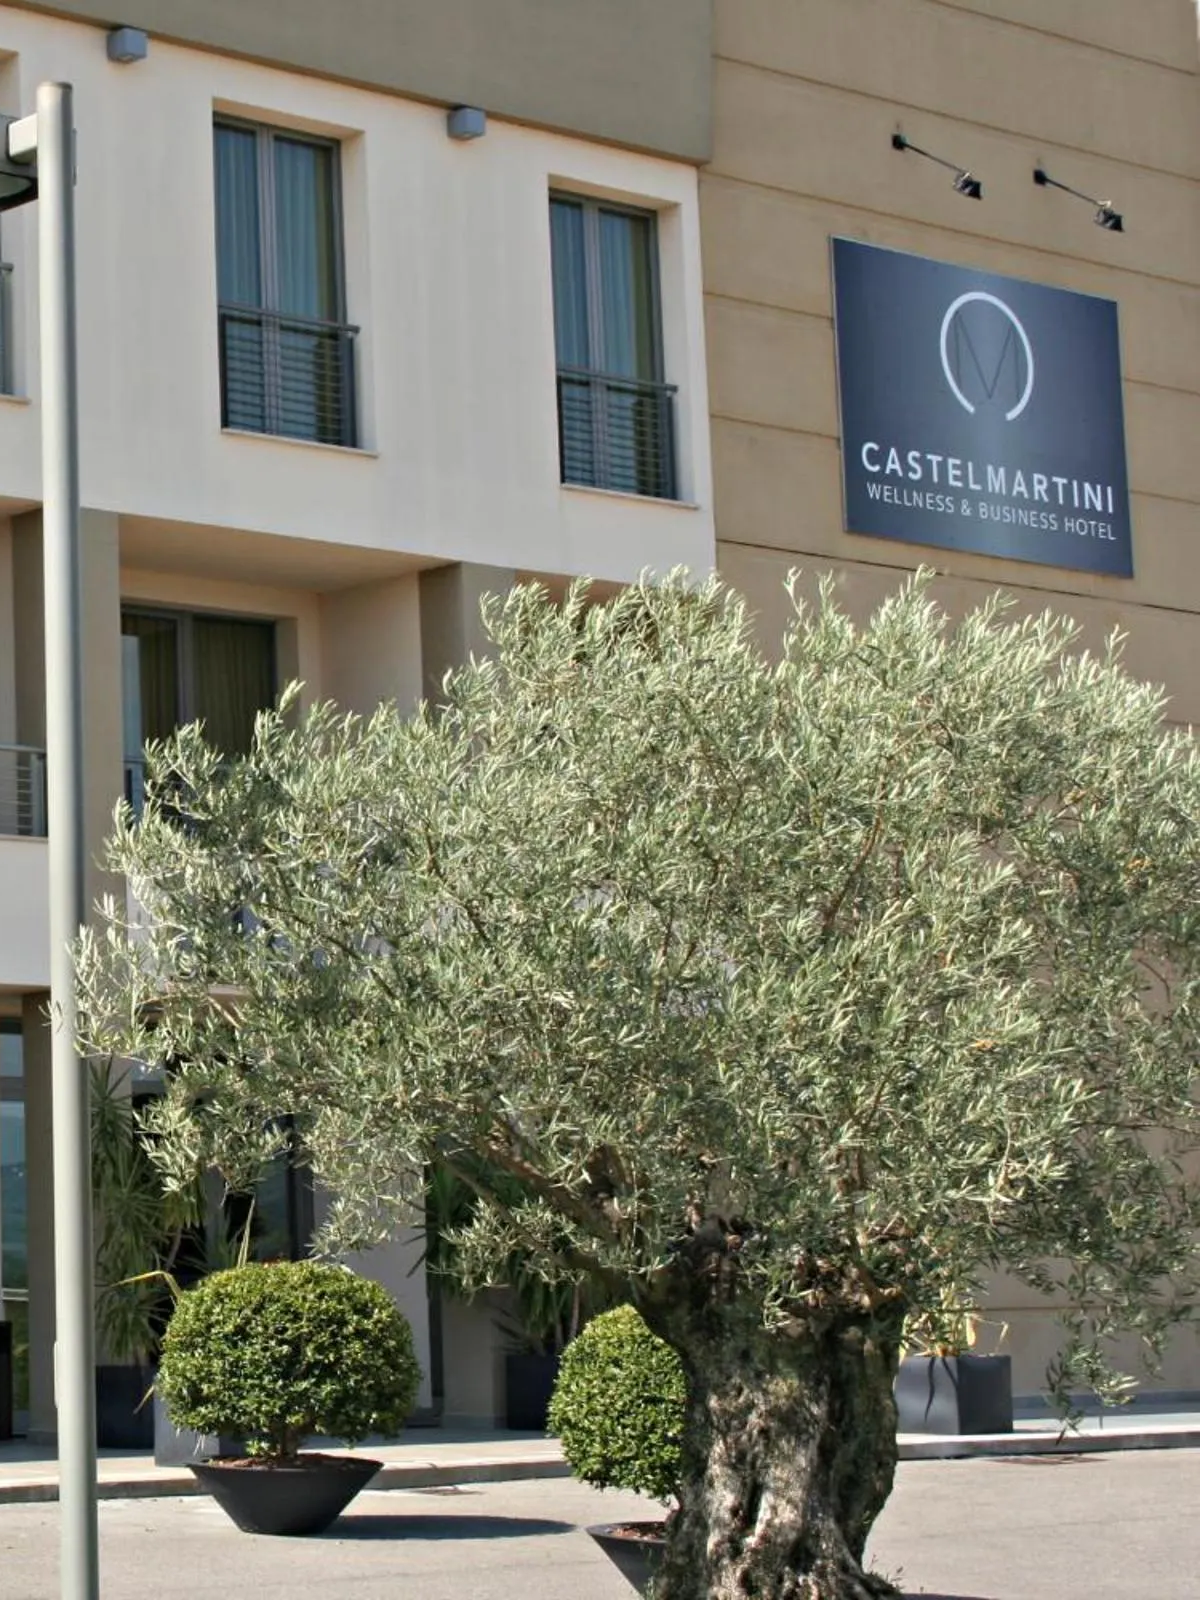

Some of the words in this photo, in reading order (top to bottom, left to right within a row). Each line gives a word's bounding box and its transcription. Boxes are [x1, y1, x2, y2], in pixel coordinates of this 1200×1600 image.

[861, 441, 1114, 514] CASTELMARTINI
[866, 481, 955, 514] WELLNESS
[960, 499, 973, 516] &
[978, 502, 1059, 531] BUSINESS
[1064, 517, 1117, 541] HOTEL
